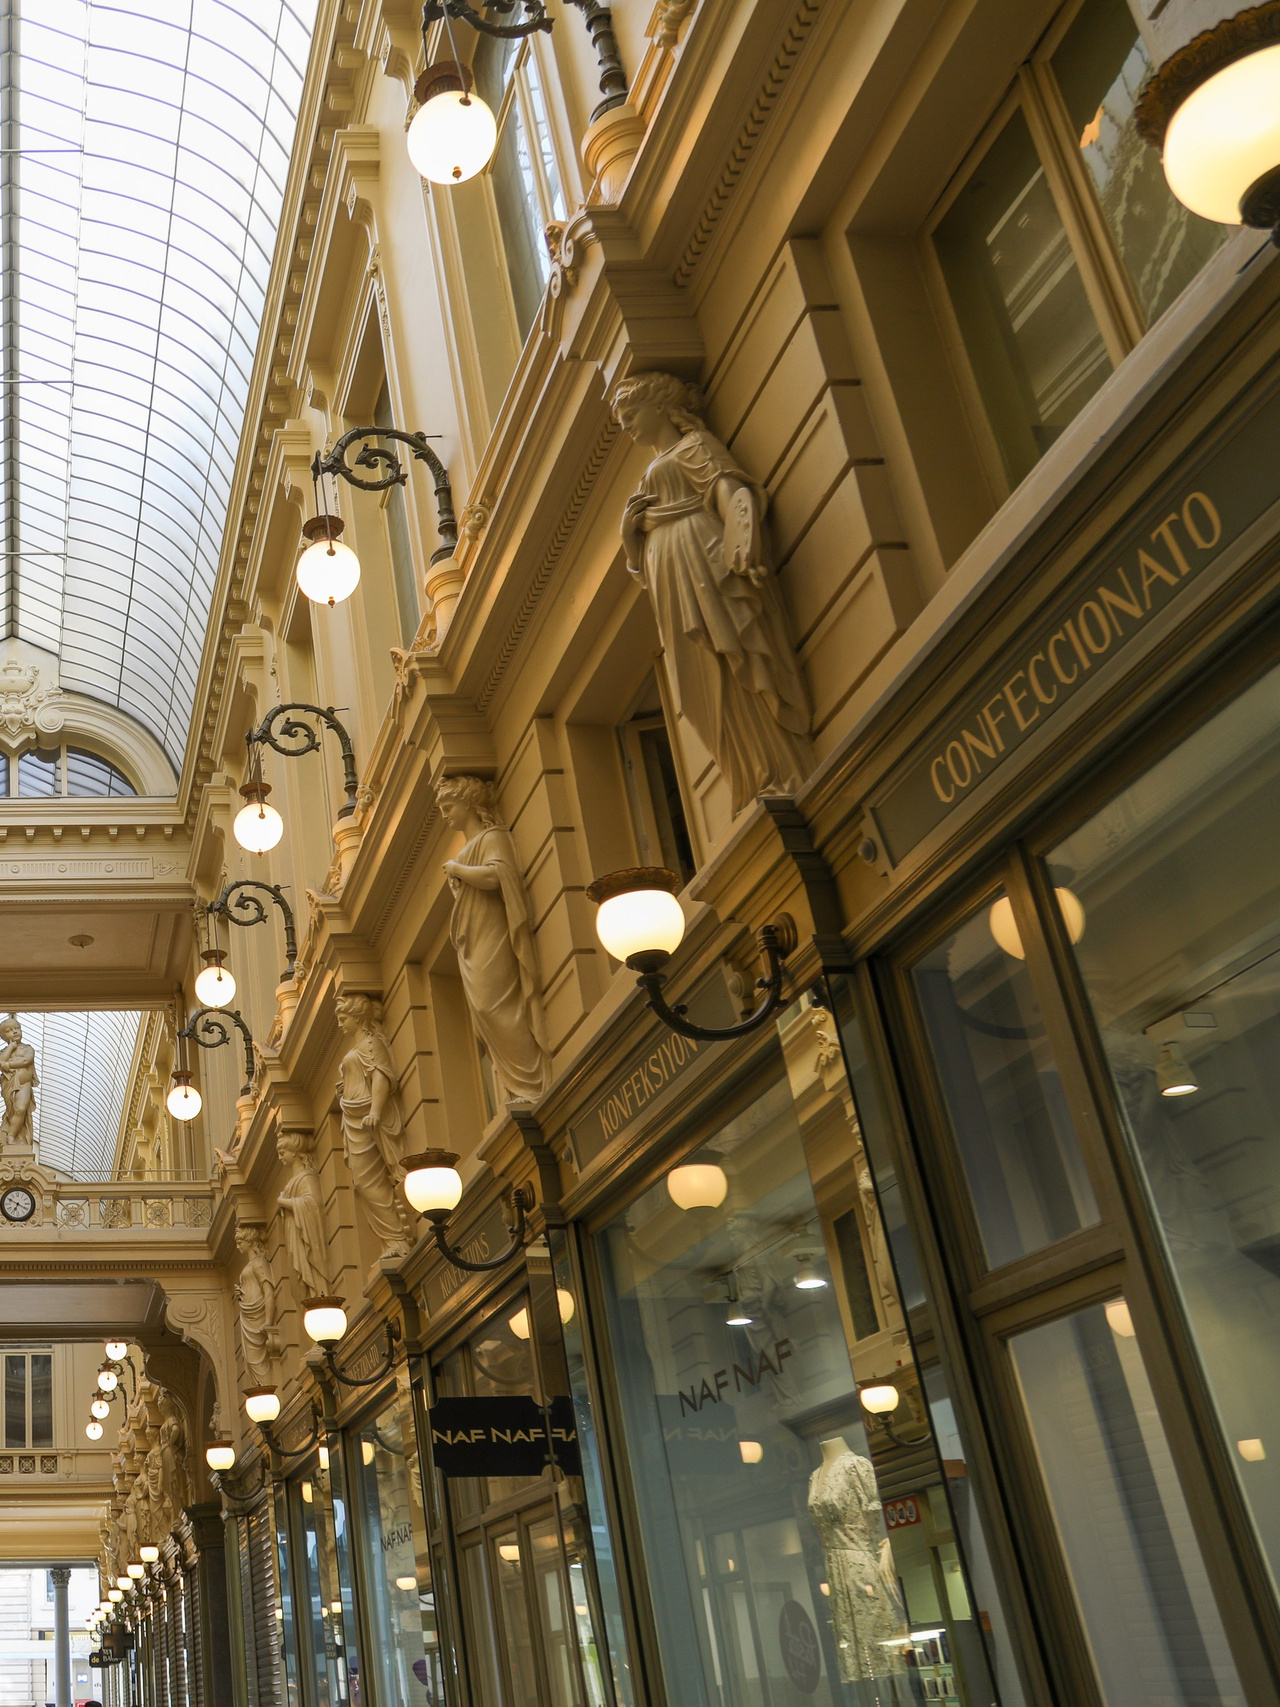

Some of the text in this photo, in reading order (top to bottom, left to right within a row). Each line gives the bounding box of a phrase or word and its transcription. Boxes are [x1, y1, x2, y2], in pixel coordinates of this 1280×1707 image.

[930, 491, 1221, 803] CONFECCIONATO
[678, 1337, 792, 1418] NAF NAF
[432, 1427, 546, 1445] NAF NAF
[381, 1523, 412, 1553] NAF NAF
